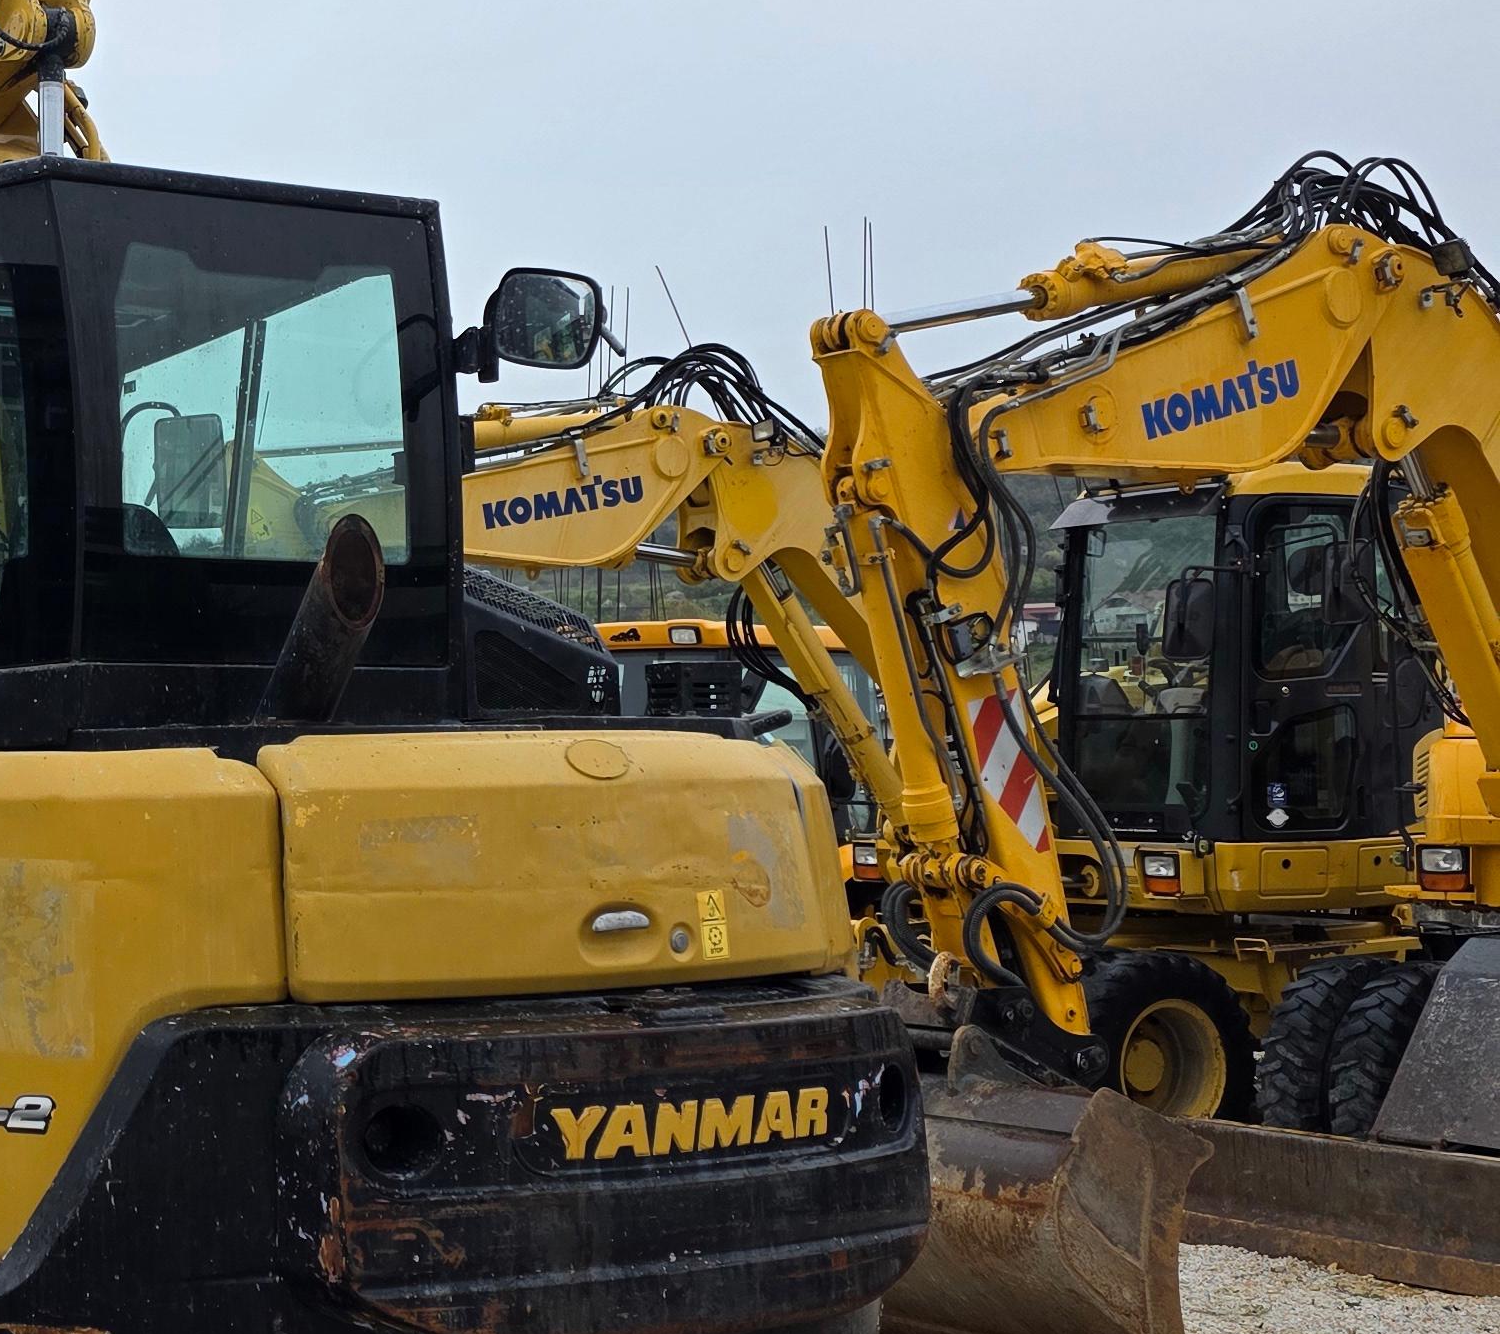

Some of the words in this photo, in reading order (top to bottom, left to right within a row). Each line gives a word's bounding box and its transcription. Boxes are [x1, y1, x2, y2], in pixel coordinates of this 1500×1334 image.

[1141, 359, 1300, 440] KOMATSU
[482, 475, 644, 530] KOMATSU
[550, 1086, 829, 1160] YANMAR
